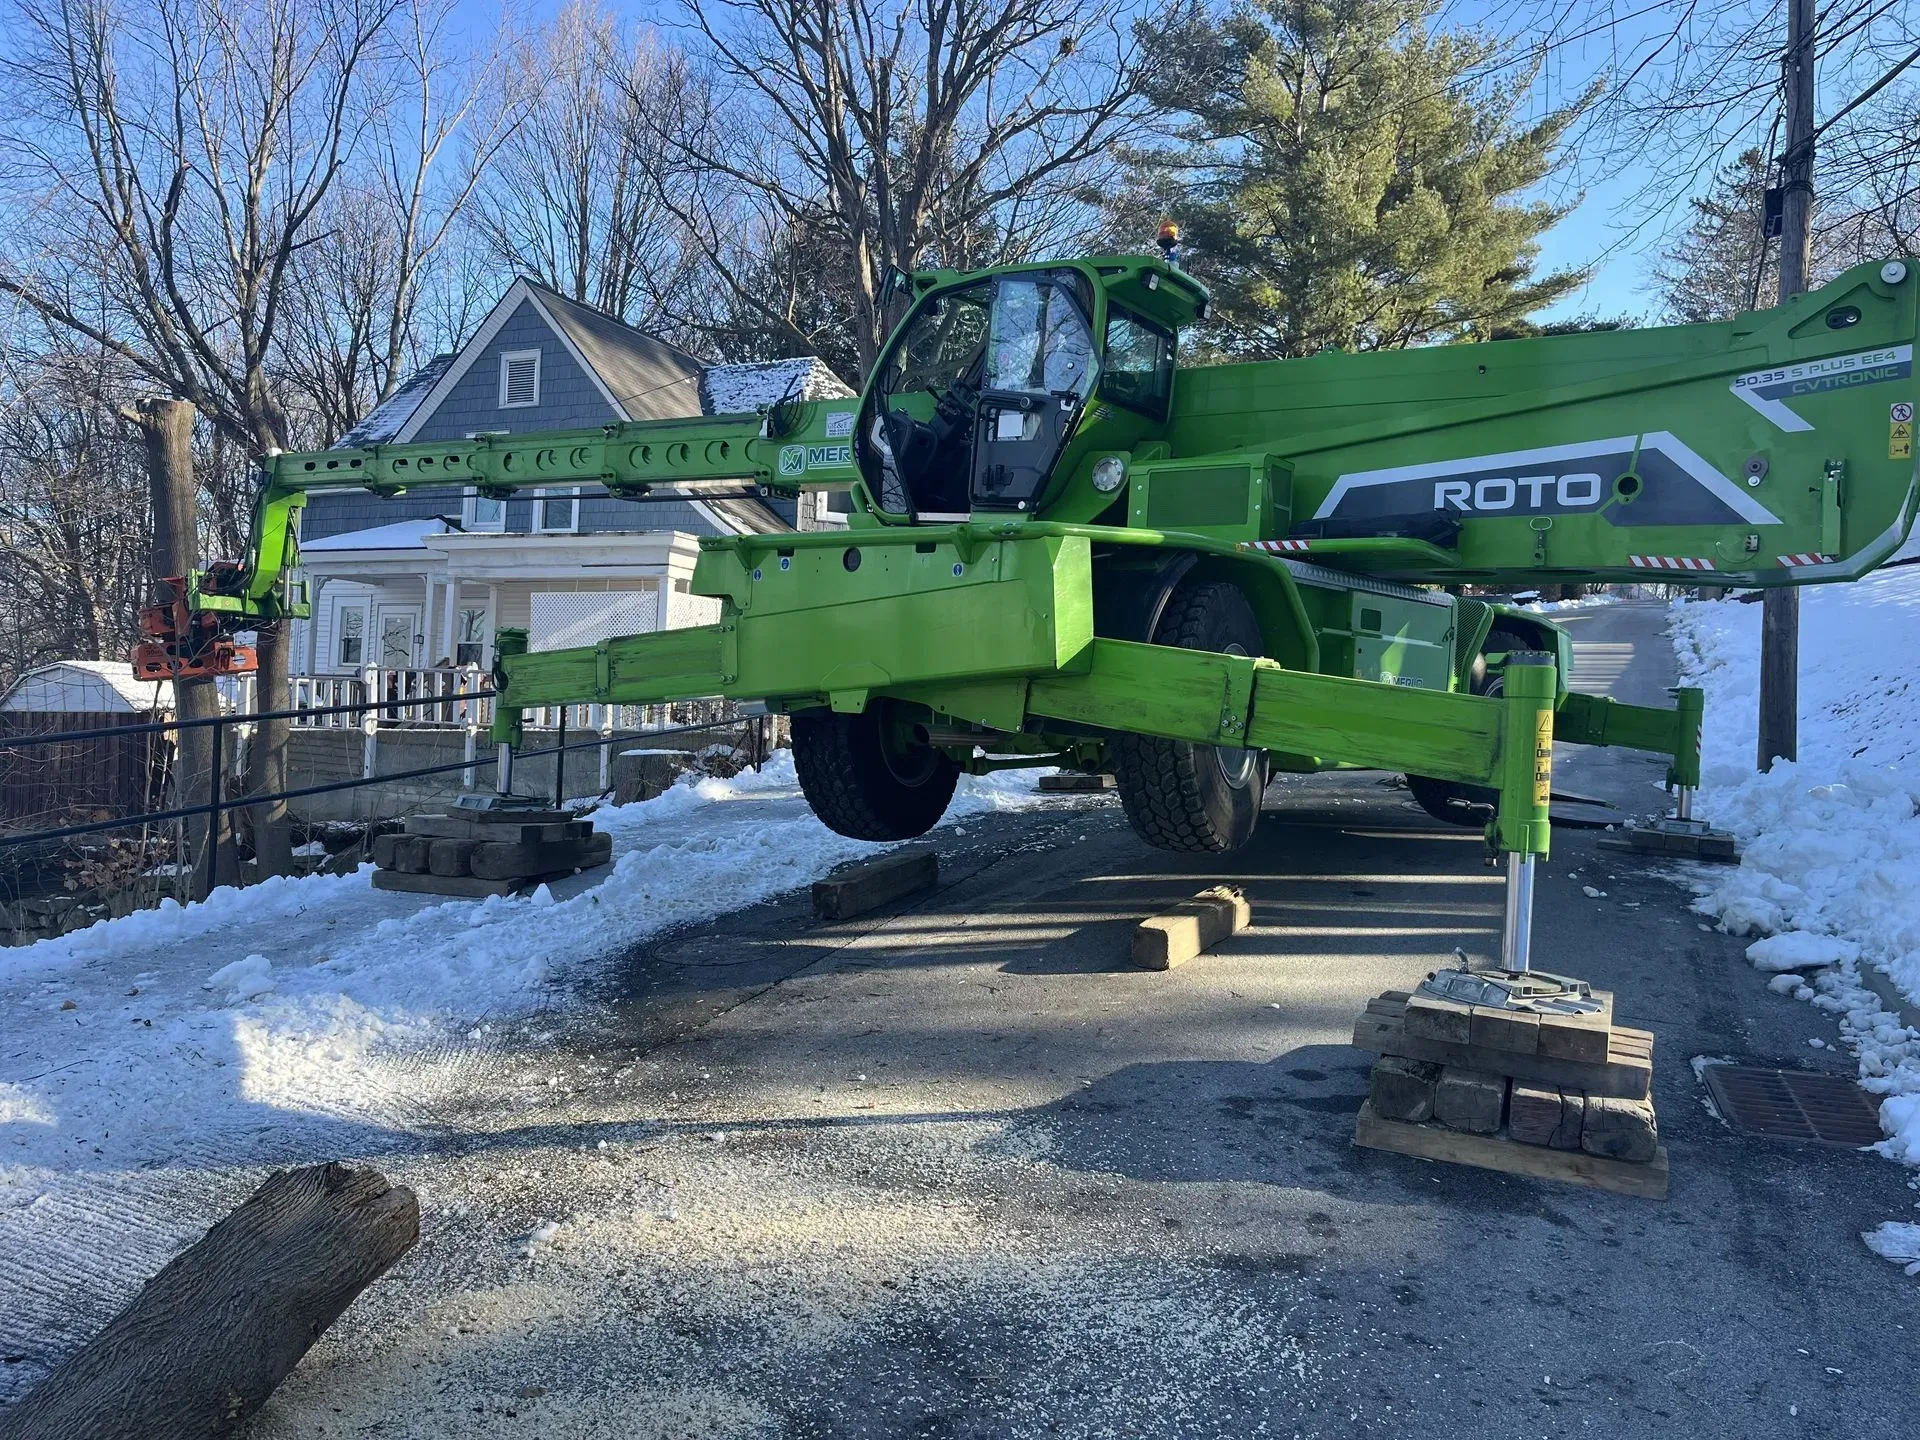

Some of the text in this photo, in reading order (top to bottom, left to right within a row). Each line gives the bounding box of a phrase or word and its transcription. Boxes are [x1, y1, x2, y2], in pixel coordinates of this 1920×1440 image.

[1735, 351, 1897, 388] 50.35 S PLUS EE4
[1791, 366, 1899, 394] CVTRONIC
[1433, 473, 1602, 511] ROTO
